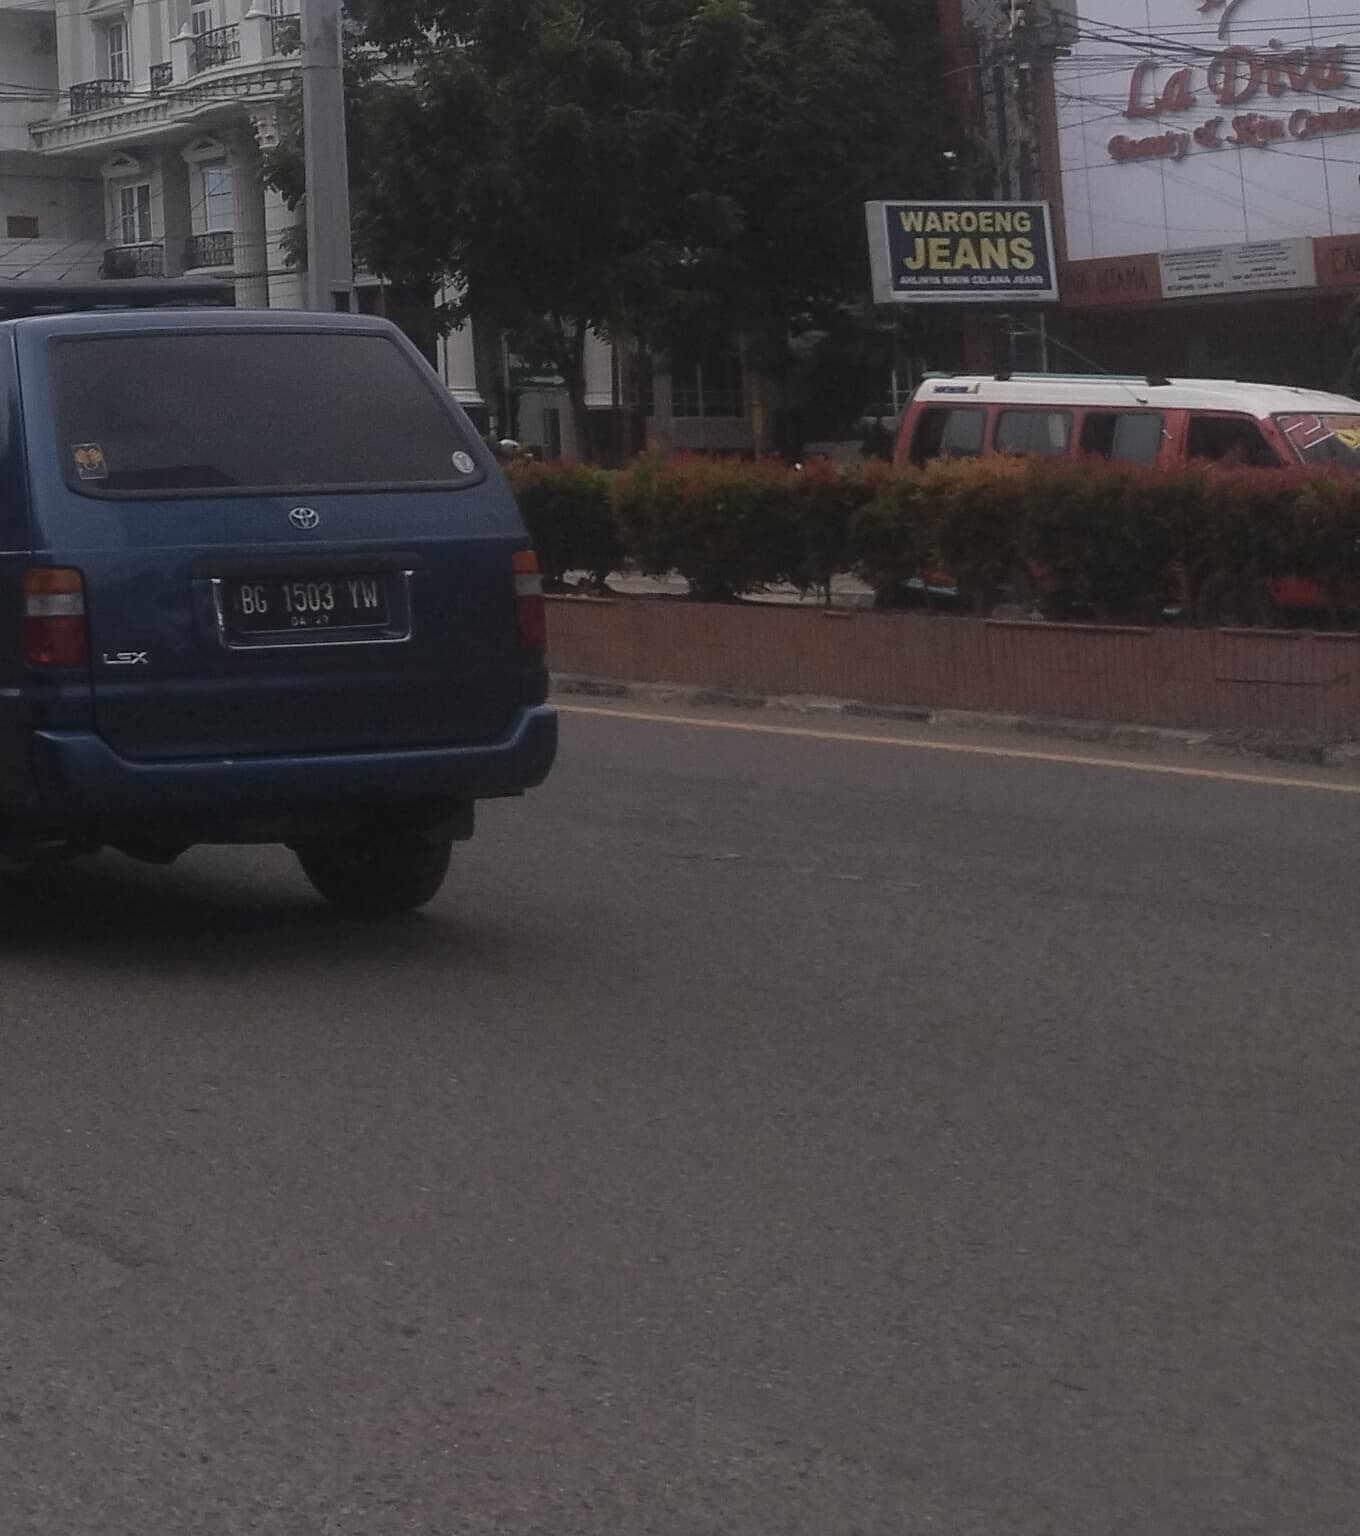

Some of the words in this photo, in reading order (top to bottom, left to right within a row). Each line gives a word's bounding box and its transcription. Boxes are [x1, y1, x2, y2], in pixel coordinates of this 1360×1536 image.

[1122, 59, 1196, 119] La
[1207, 38, 1349, 105] Diva
[1289, 106, 1360, 137] Cente
[899, 210, 1032, 232] WAROENG
[904, 237, 1035, 270] JEANS
[1012, 275, 1044, 285] JEANS
[240, 585, 268, 614] BG
[282, 582, 336, 613] 1503
[347, 579, 379, 609] YW
